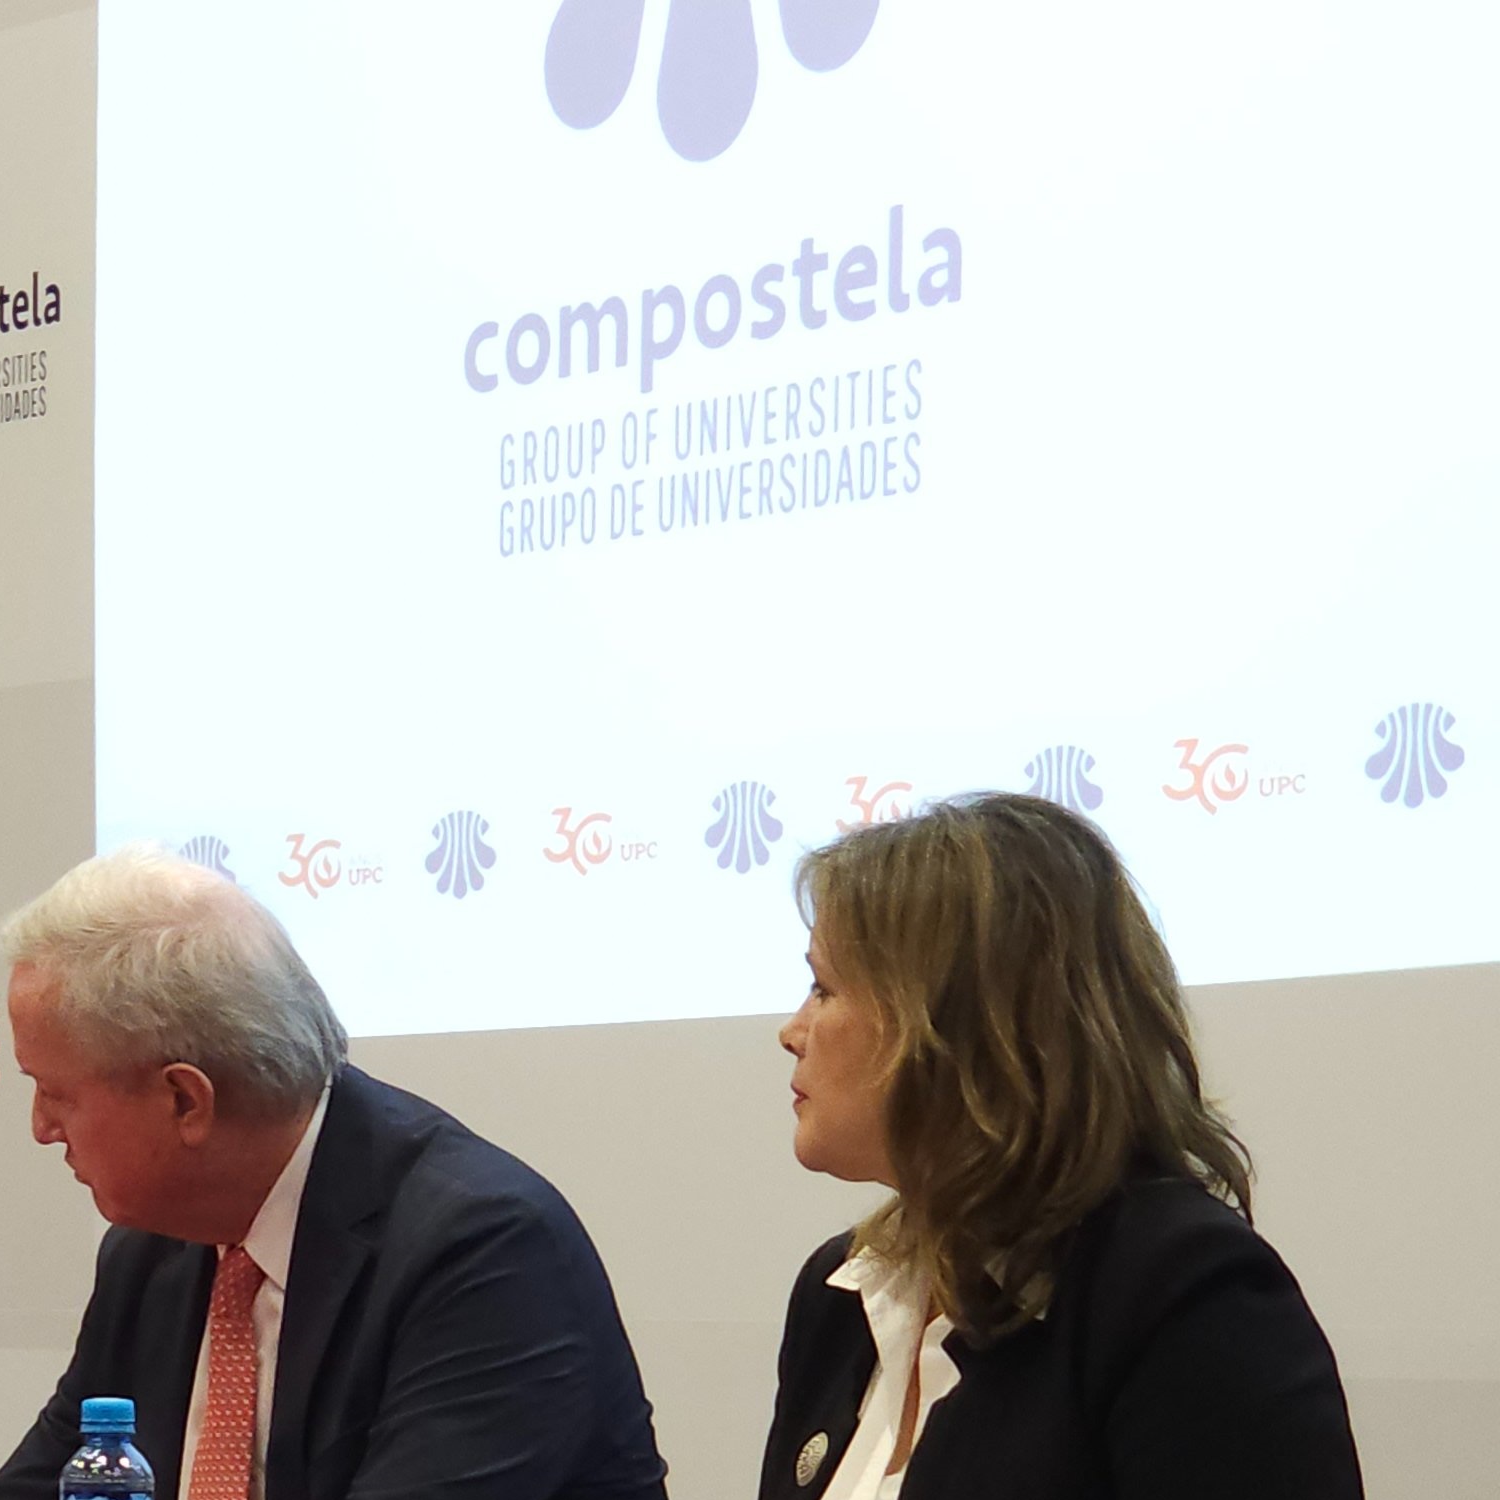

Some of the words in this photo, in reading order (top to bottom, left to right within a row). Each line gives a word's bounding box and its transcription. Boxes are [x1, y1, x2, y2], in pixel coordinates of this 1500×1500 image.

[464, 204, 963, 394] compostela
[500, 418, 605, 490] GROUP
[621, 408, 658, 470] OF
[675, 359, 923, 460] UNIVERSITIES
[500, 487, 596, 557] GRUPO
[610, 480, 645, 540] DE
[658, 432, 922, 533] UNIVERSIDADES
[1258, 774, 1306, 798] UPC
[348, 866, 384, 887] UPC
[620, 841, 658, 862] UPC
